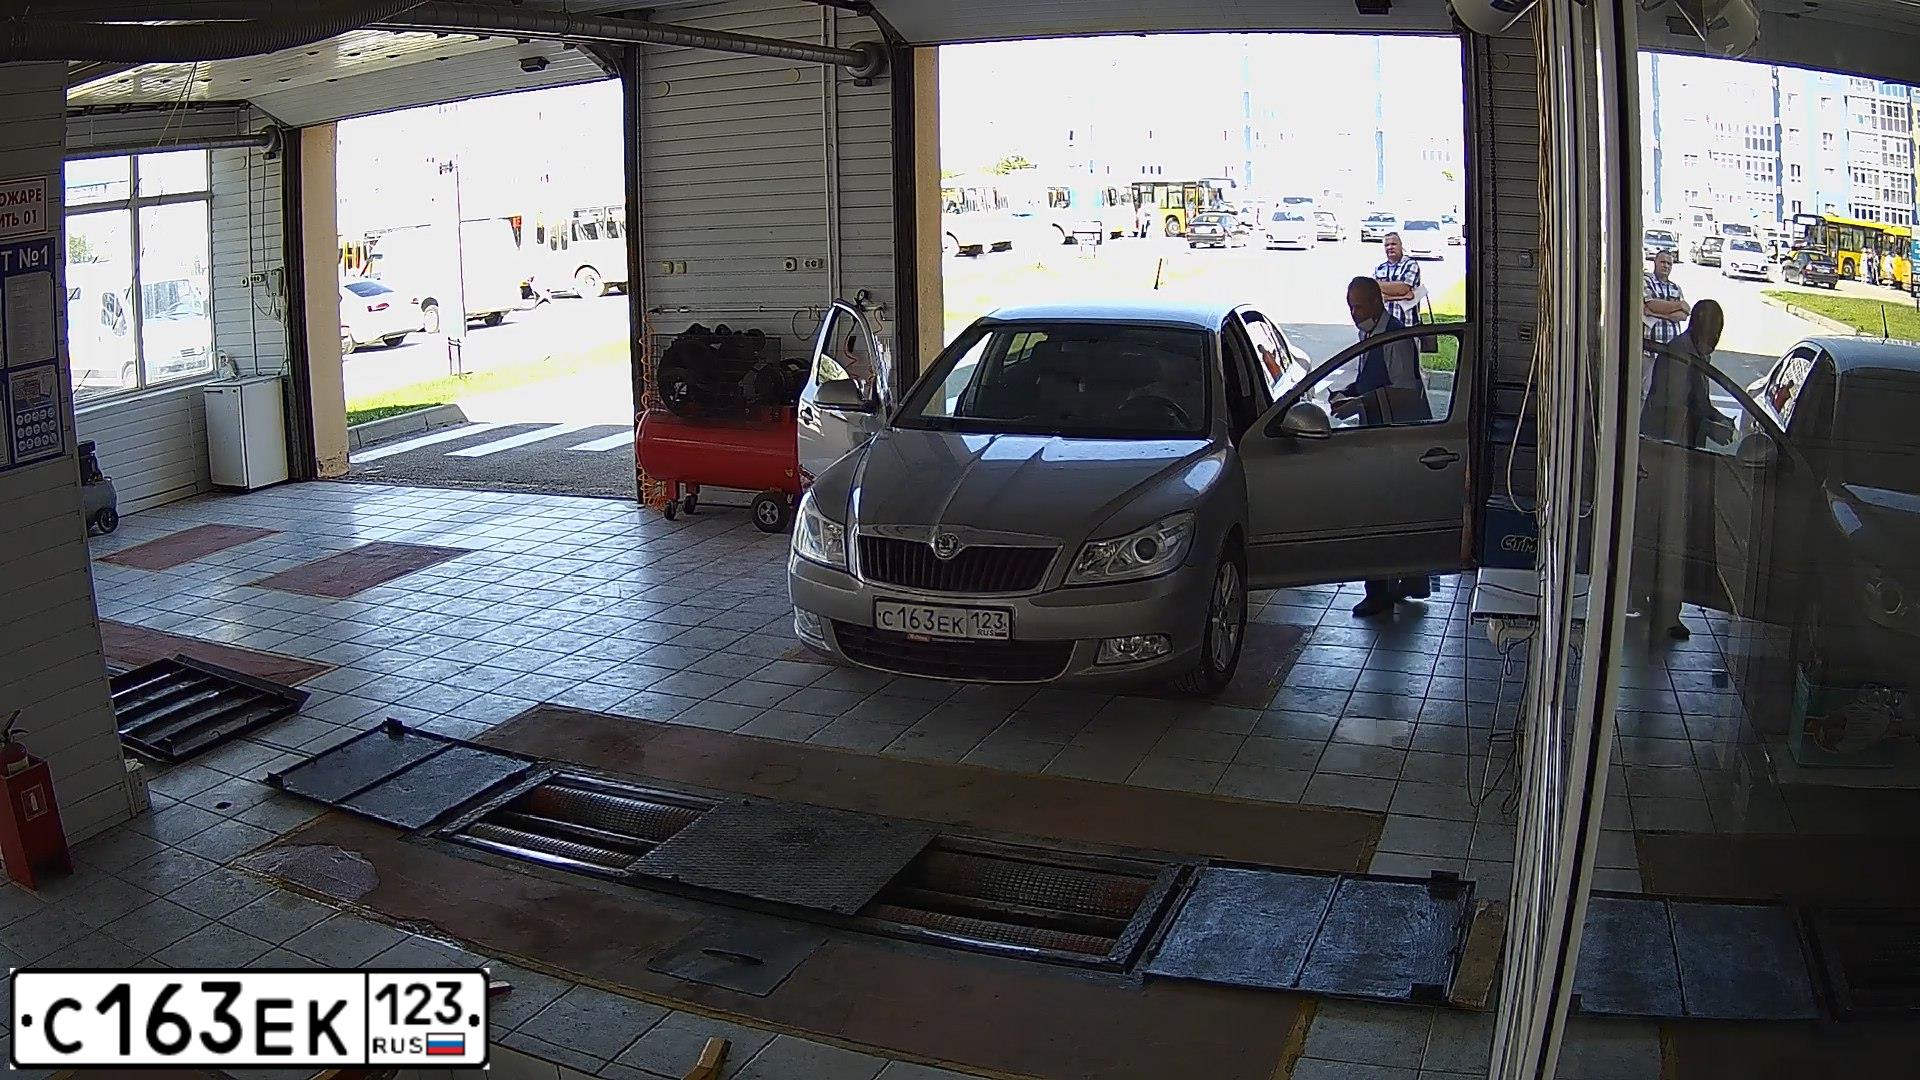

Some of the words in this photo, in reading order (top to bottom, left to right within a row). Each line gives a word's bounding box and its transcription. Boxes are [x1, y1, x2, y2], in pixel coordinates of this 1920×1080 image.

[24, 210, 37, 225] 01
[971, 612, 1004, 630] 123
[977, 629, 994, 637] RUS
